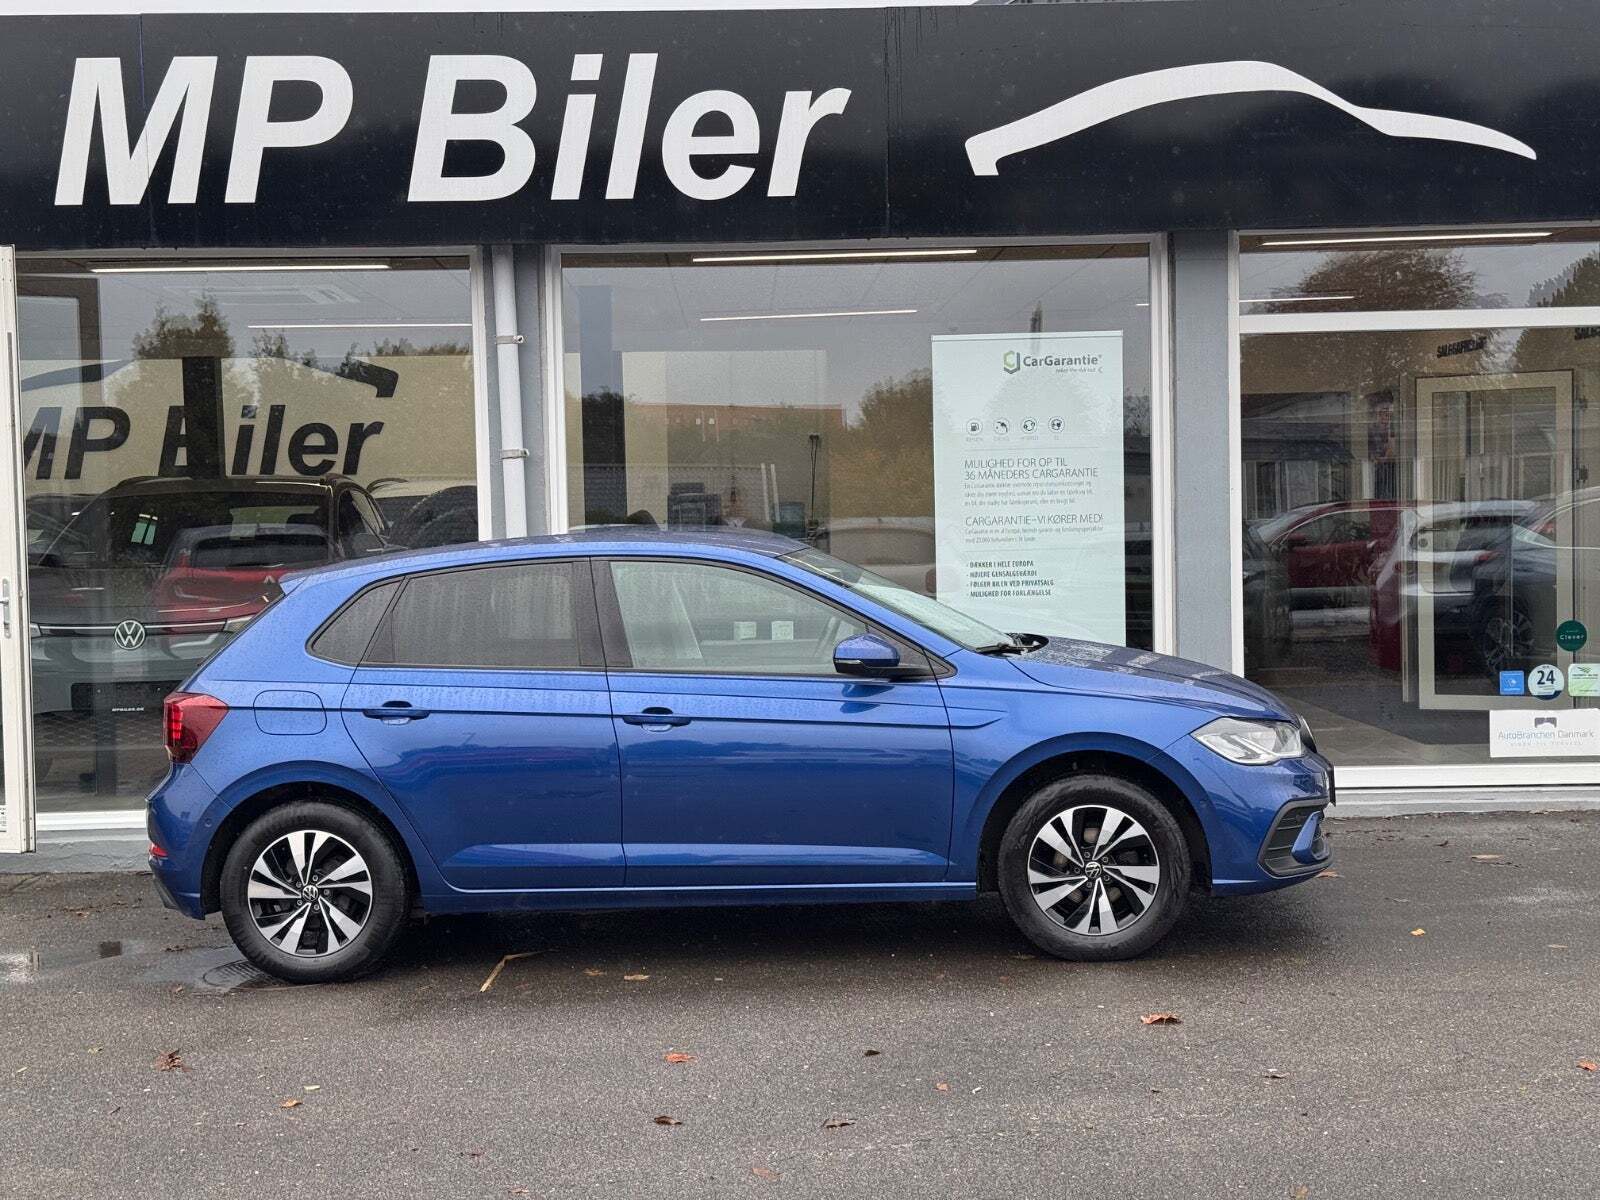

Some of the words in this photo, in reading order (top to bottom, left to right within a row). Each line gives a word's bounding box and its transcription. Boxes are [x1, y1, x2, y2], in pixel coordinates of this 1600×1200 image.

[54, 55, 354, 206] MP
[406, 52, 852, 203] Biler
[1023, 354, 1098, 367] CarGarantie
[964, 458, 1015, 468] MULIGHED
[1017, 458, 1037, 468] FOR
[1039, 458, 1053, 467] OP
[1055, 457, 1068, 467] TIL
[964, 471, 976, 480] 36
[978, 468, 1030, 480] MÅNEDERS
[1032, 467, 1098, 479] CARGARANTIE
[1047, 513, 1078, 524] KØRER
[1537, 670, 1556, 685] 24
